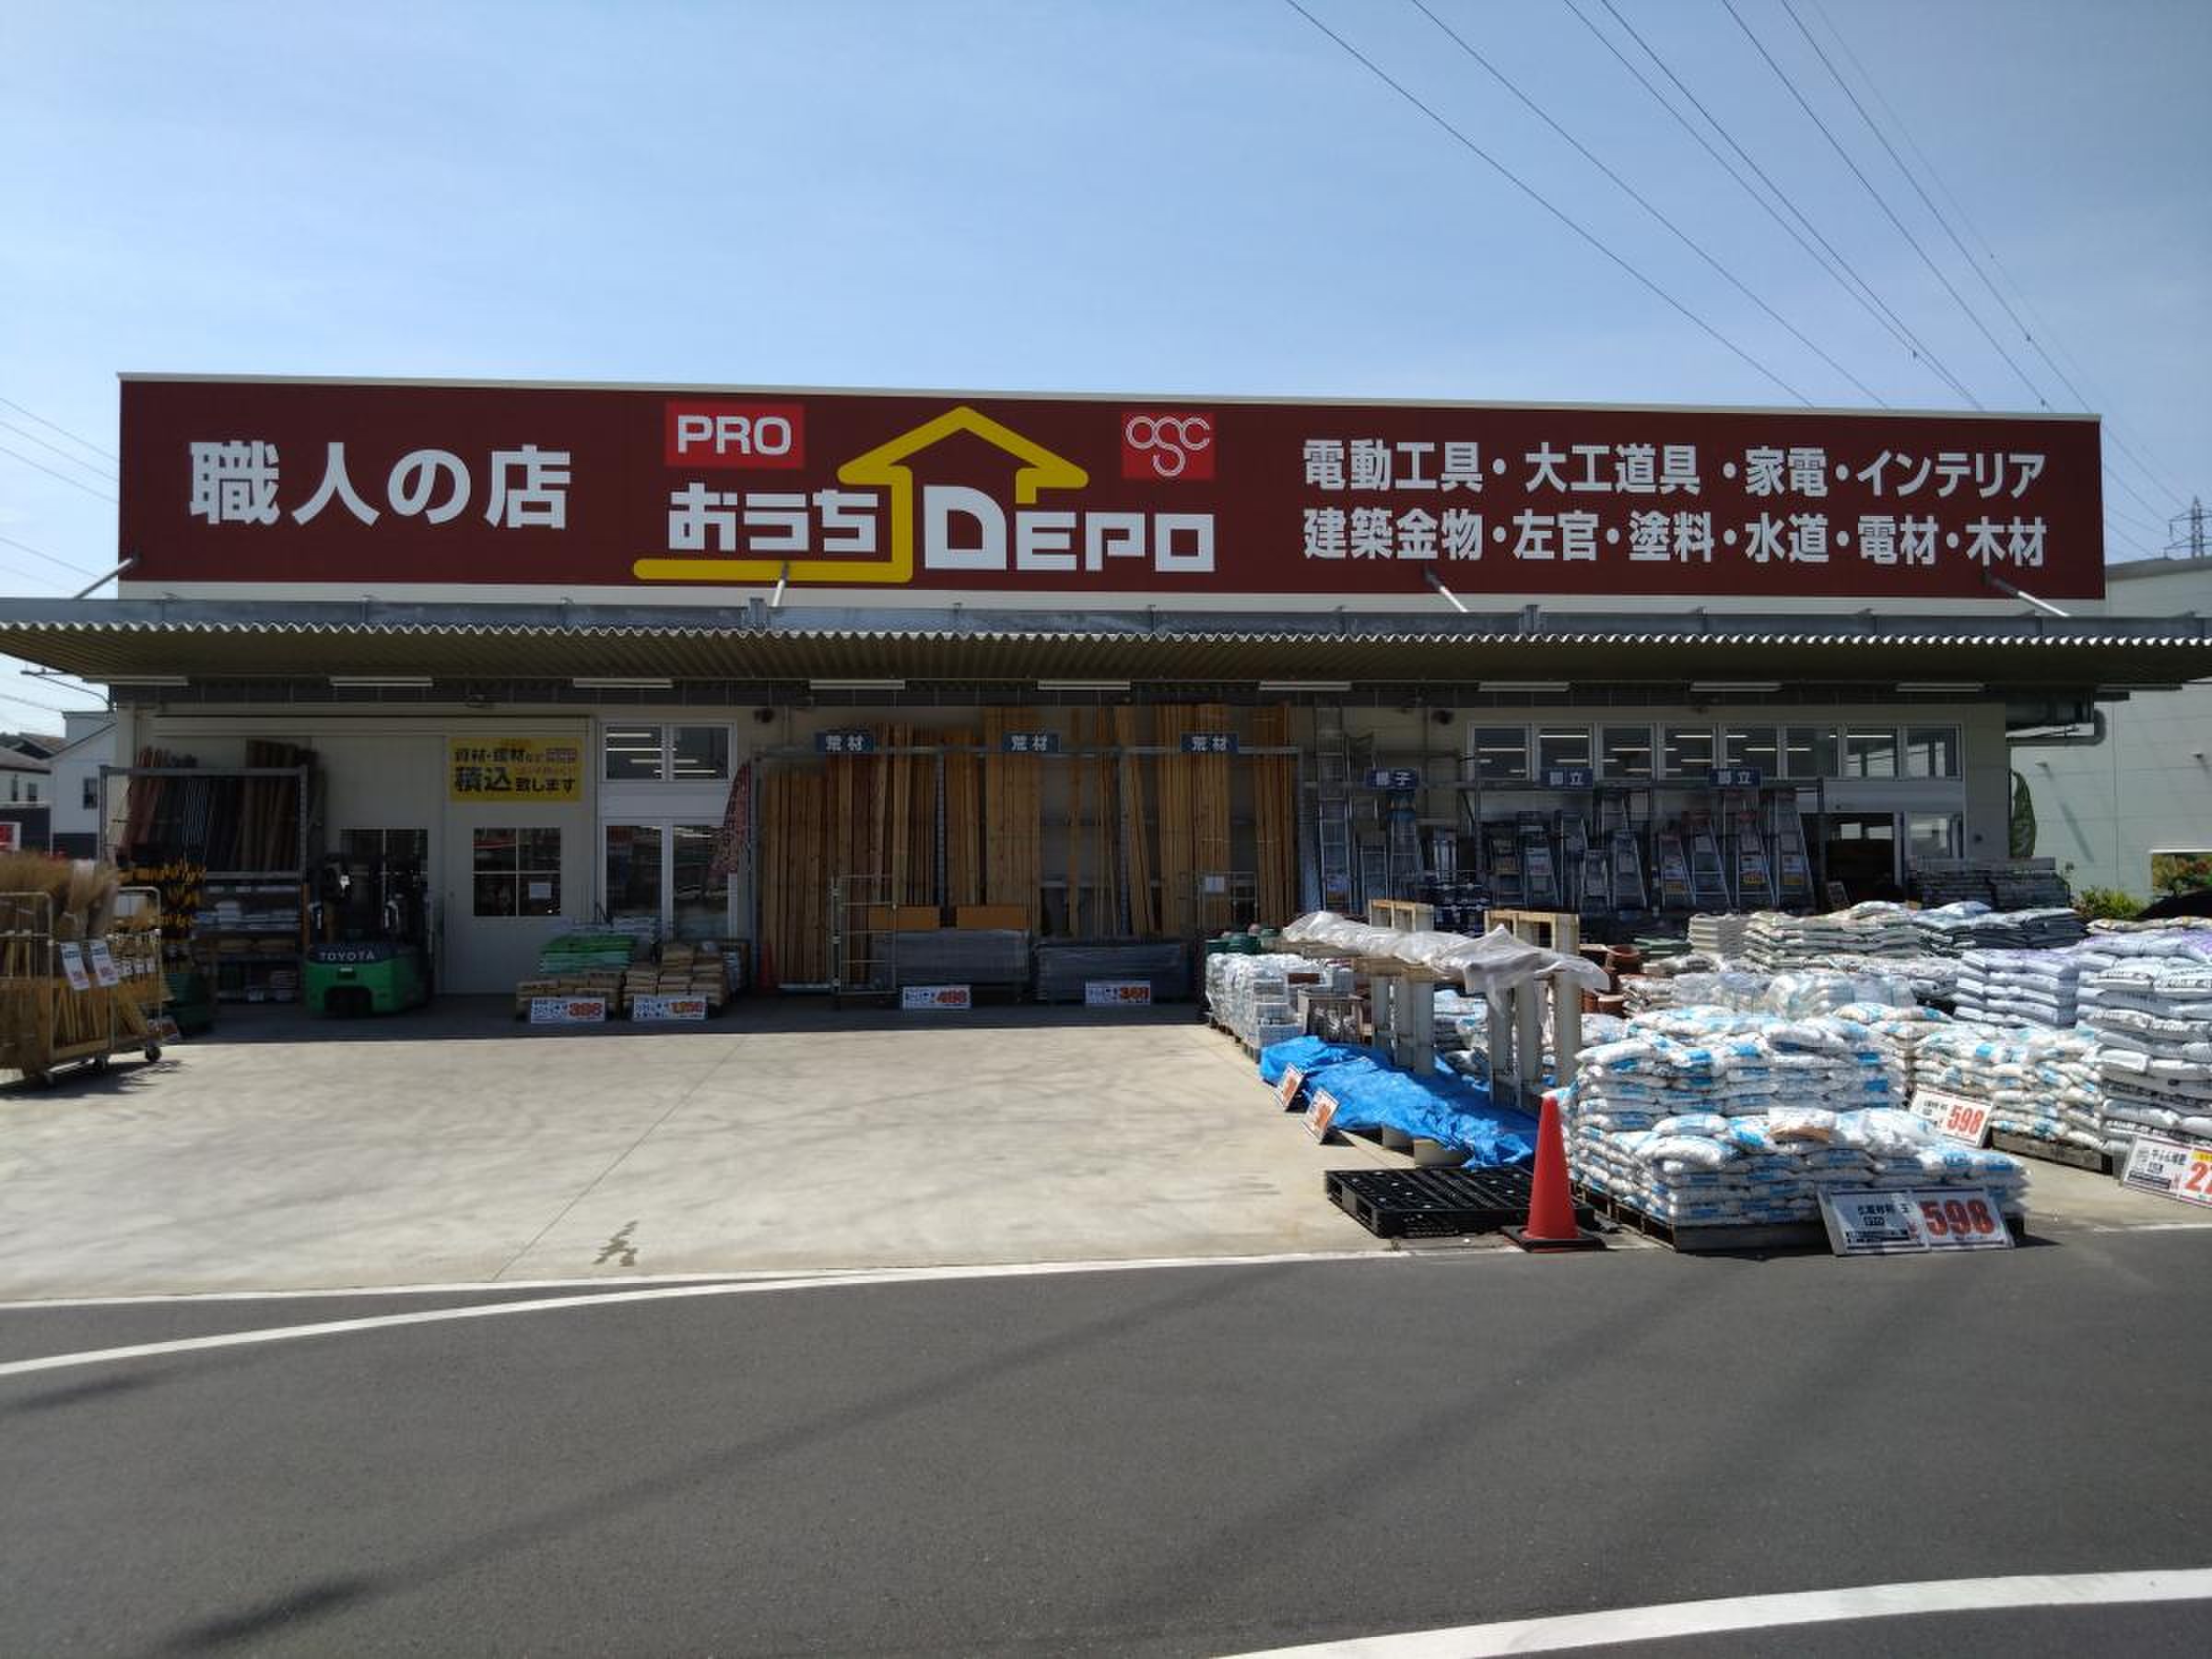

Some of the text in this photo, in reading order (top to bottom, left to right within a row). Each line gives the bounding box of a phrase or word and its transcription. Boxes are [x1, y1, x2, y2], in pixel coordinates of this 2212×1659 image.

[677, 414, 792, 455] PRO
[189, 440, 571, 529] 職人の店
[668, 482, 878, 553] おうち
[320, 949, 375, 961] TOYOTA
[1947, 1104, 1985, 1135] 598
[1919, 1199, 1995, 1236] 598
